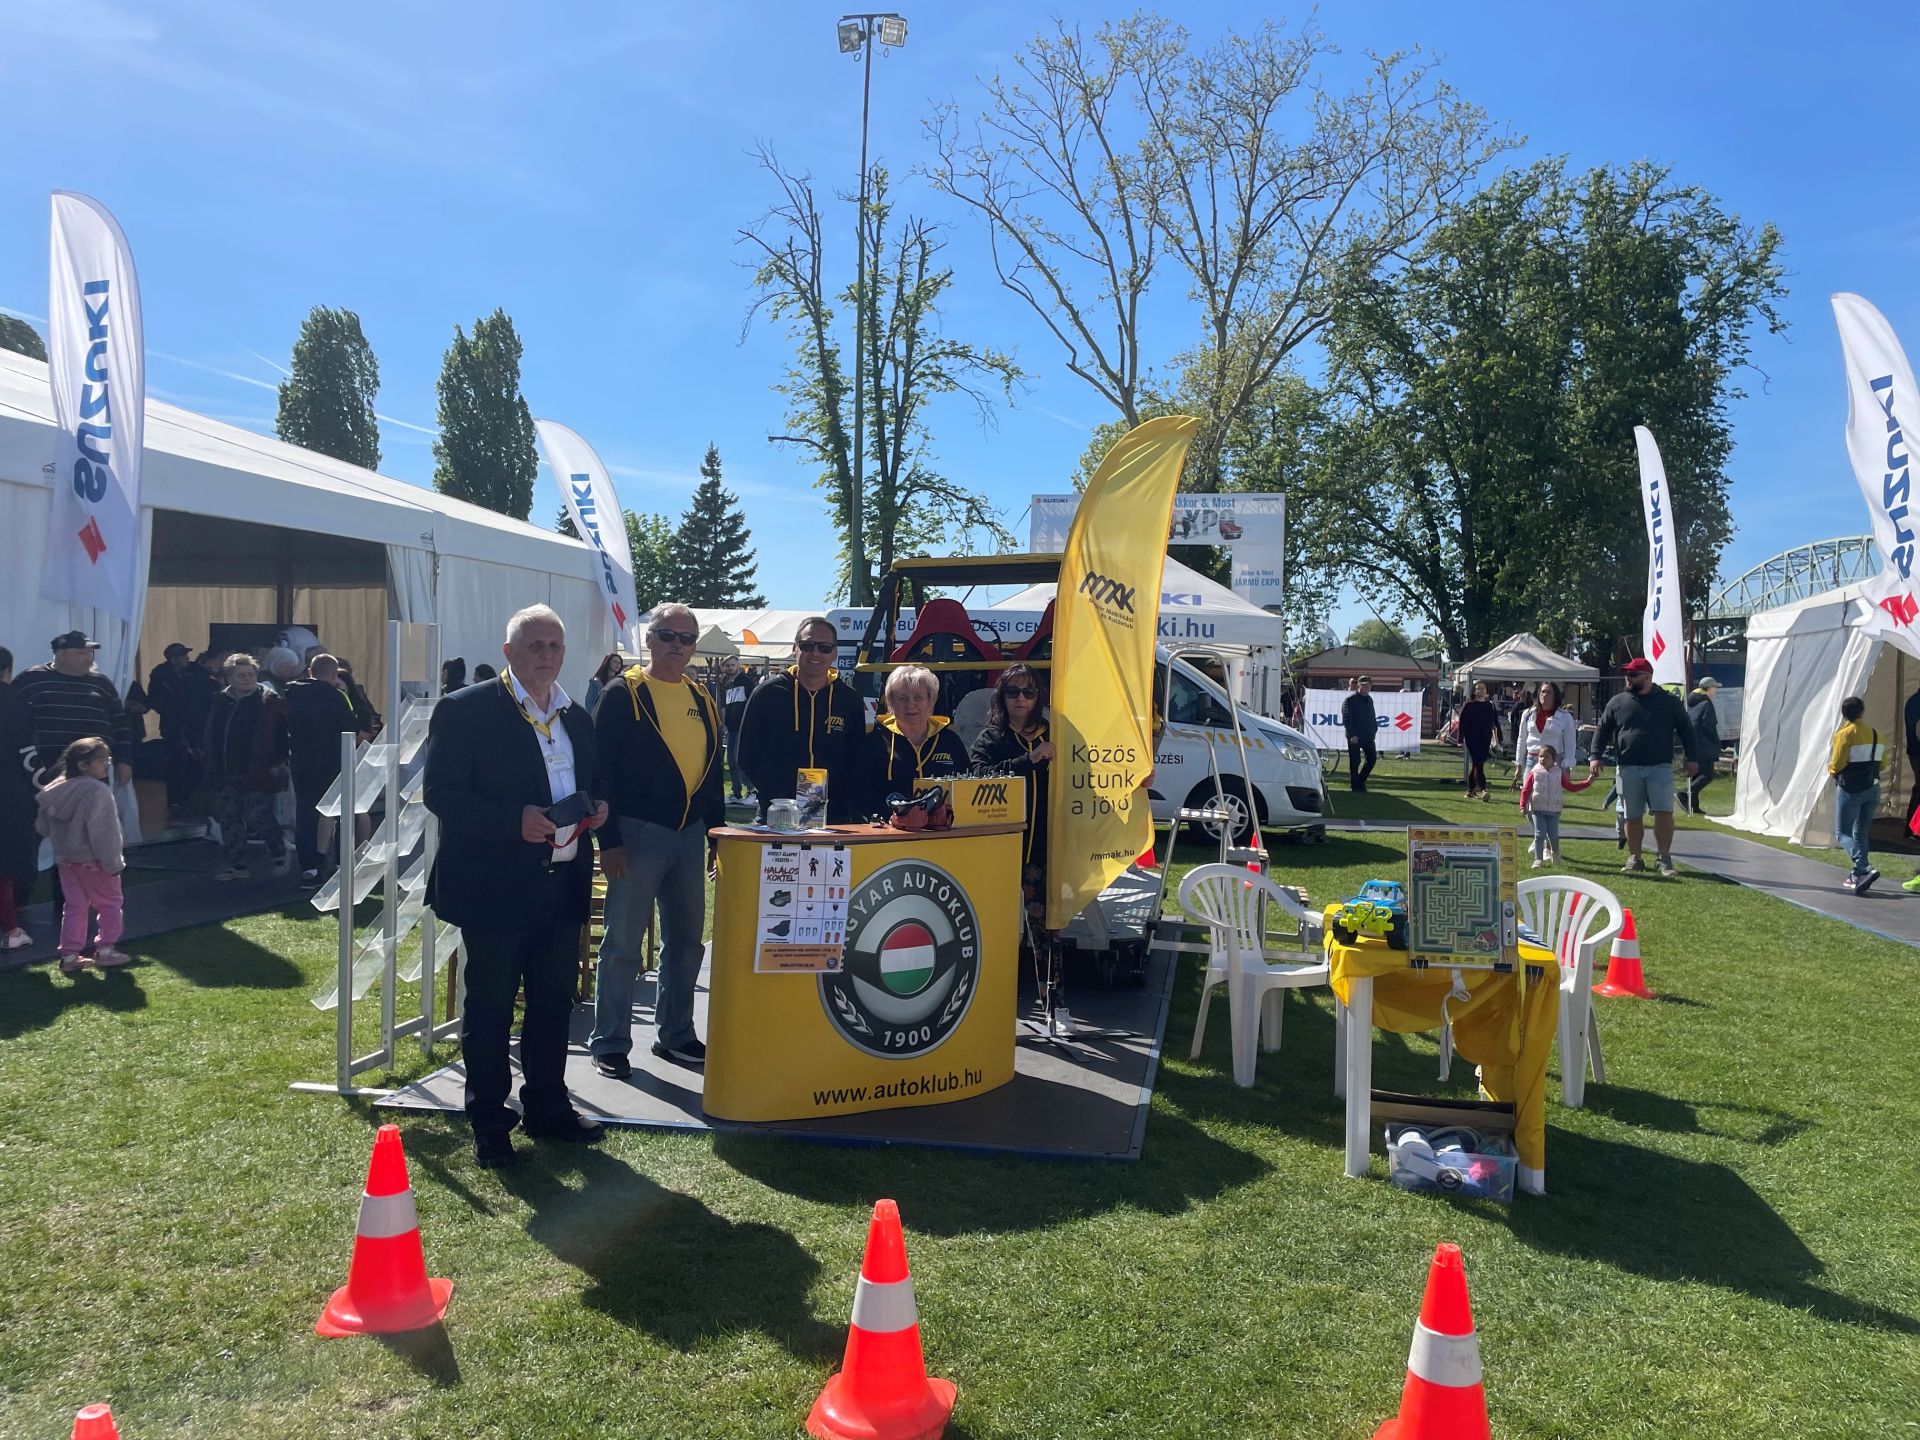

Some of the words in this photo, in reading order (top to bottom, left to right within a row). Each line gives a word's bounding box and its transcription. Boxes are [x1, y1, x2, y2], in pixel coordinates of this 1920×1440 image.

[1201, 498, 1209, 508] &
[1213, 497, 1236, 508] Most
[1262, 577, 1280, 586] EXPO
[1160, 593, 1202, 606] KI
[1015, 621, 1040, 633] CEN
[1157, 617, 1215, 639] ki.hu
[1072, 744, 1136, 763] Közös
[1072, 769, 1135, 789] utunk
[1071, 800, 1084, 815] a
[1090, 848, 1135, 862] /mmak.hu
[845, 877, 895, 943] GYAR
[903, 871, 974, 960] AUTÓKLUB
[883, 1026, 931, 1047] 1900
[813, 1068, 982, 1106] www.autoklub.hu
